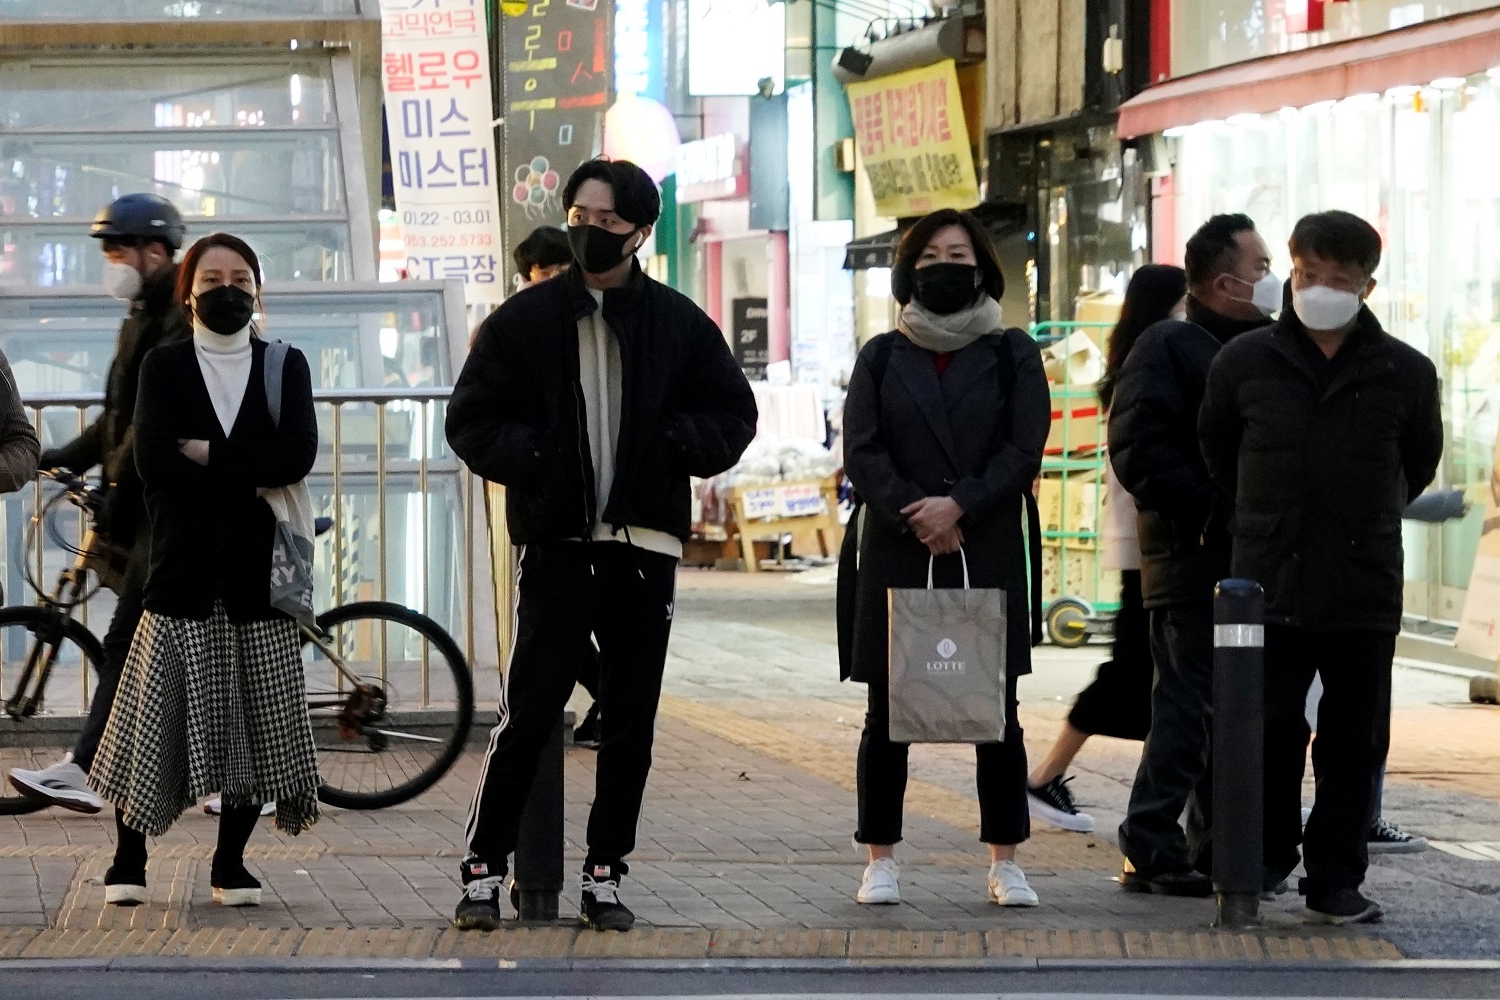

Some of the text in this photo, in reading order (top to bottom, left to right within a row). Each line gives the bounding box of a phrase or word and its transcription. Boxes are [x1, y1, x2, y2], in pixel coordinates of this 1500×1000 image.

[381, 9, 476, 36] 코믹연극
[384, 49, 482, 92] 헬로우
[402, 97, 471, 138] 미스
[398, 148, 489, 189] 미스터
[453, 208, 491, 225] 03.01
[403, 233, 493, 248] 053.252.5733
[926, 661, 965, 671] LOTTE
